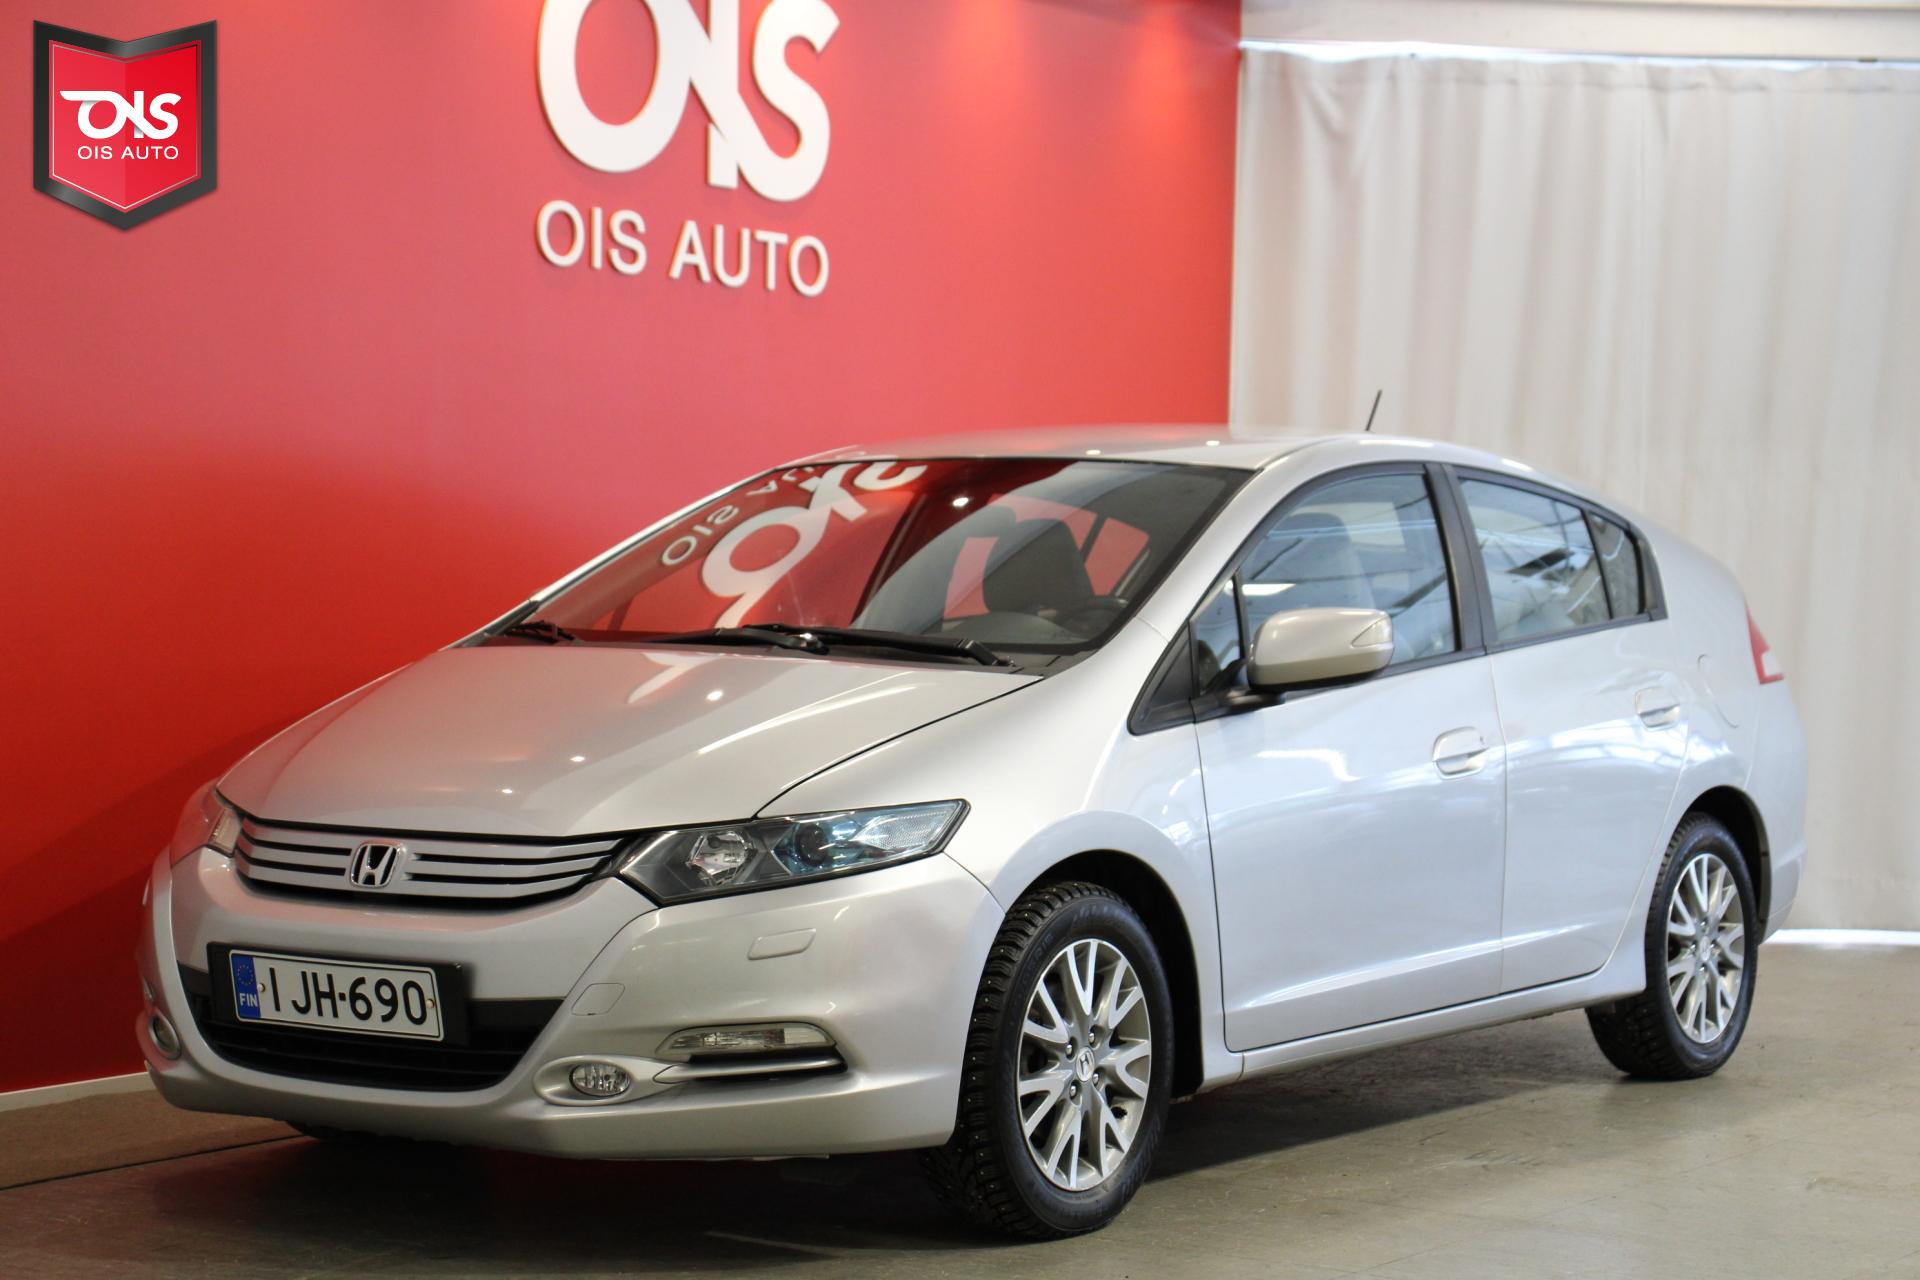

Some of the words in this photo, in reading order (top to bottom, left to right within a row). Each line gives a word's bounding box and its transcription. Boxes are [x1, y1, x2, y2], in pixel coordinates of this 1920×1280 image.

[536, 200, 647, 276] OIS
[669, 219, 830, 297] AUTO
[239, 992, 258, 1008] FIN
